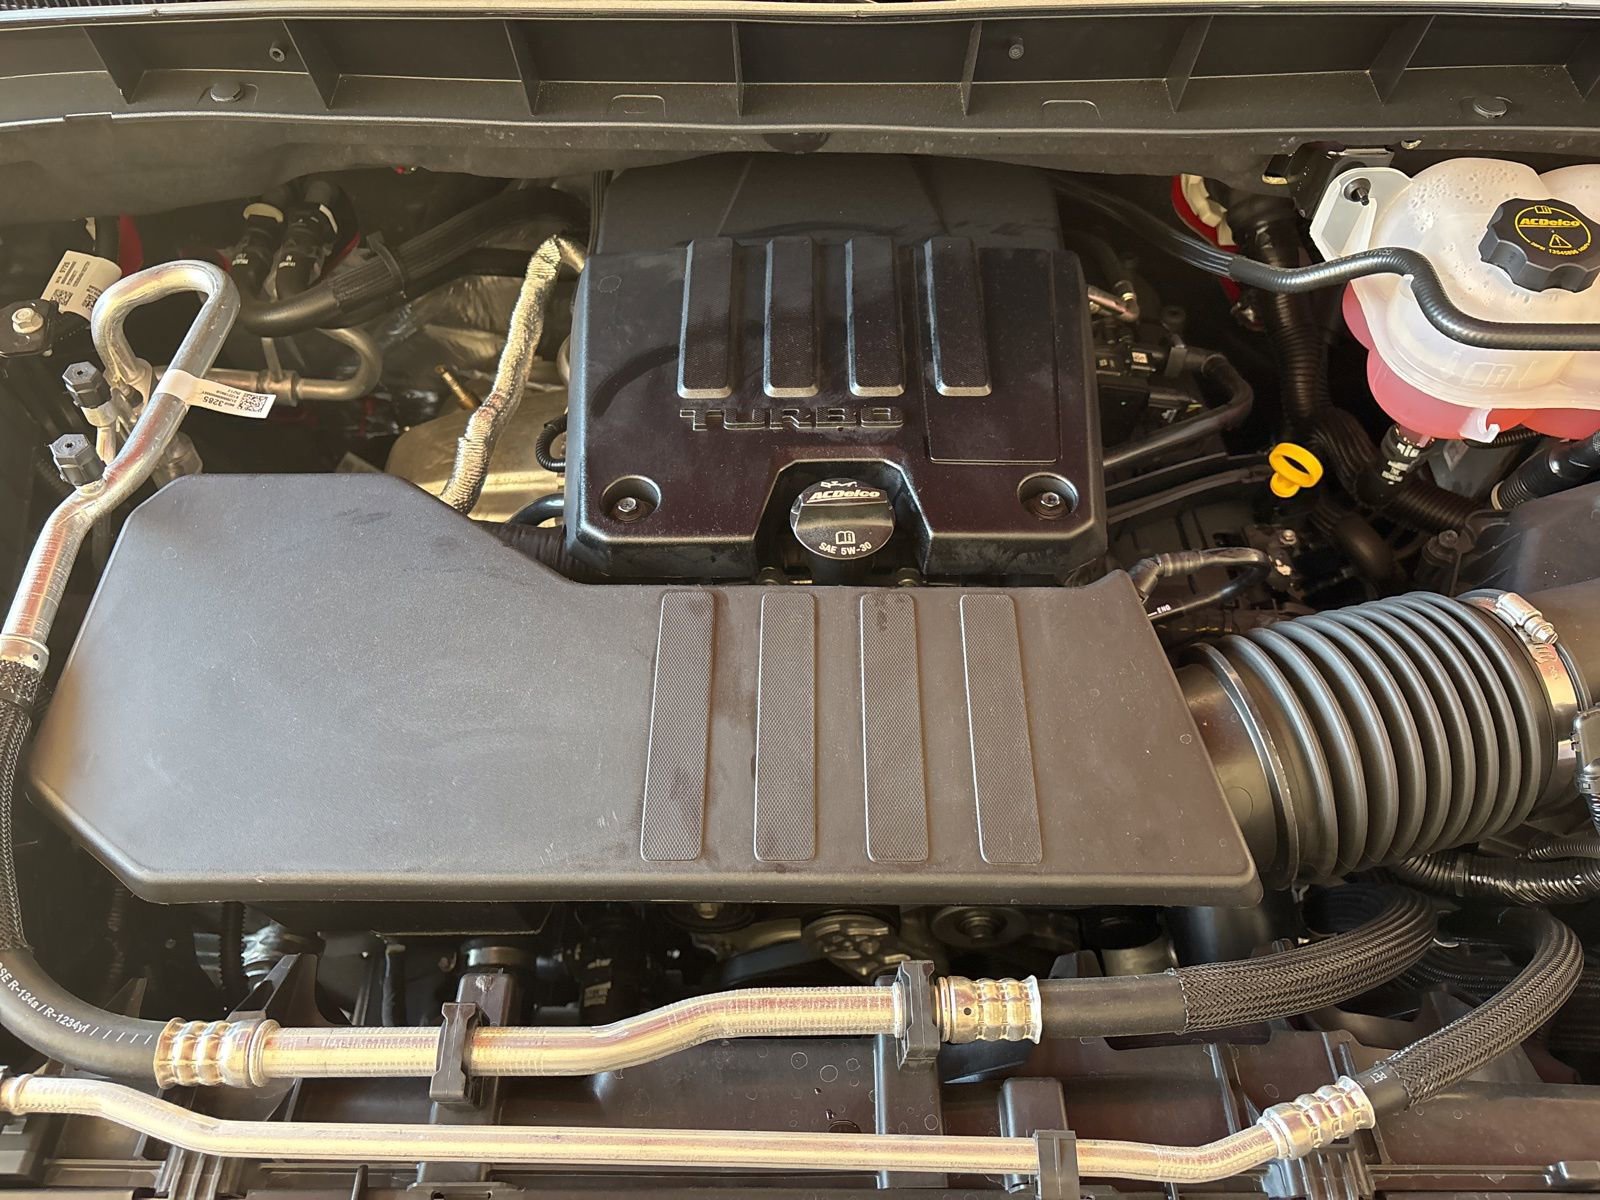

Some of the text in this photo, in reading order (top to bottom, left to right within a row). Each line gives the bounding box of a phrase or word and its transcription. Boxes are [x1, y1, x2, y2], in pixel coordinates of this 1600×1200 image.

[1518, 217, 1581, 228] ACDelco
[203, 396, 225, 407] 3285
[679, 407, 904, 431] TURBO
[807, 489, 881, 501] ACDelco
[819, 541, 872, 555] SAE 5W-30
[7, 979, 40, 1008] R-134a
[43, 1006, 91, 1033] R-1234yf
